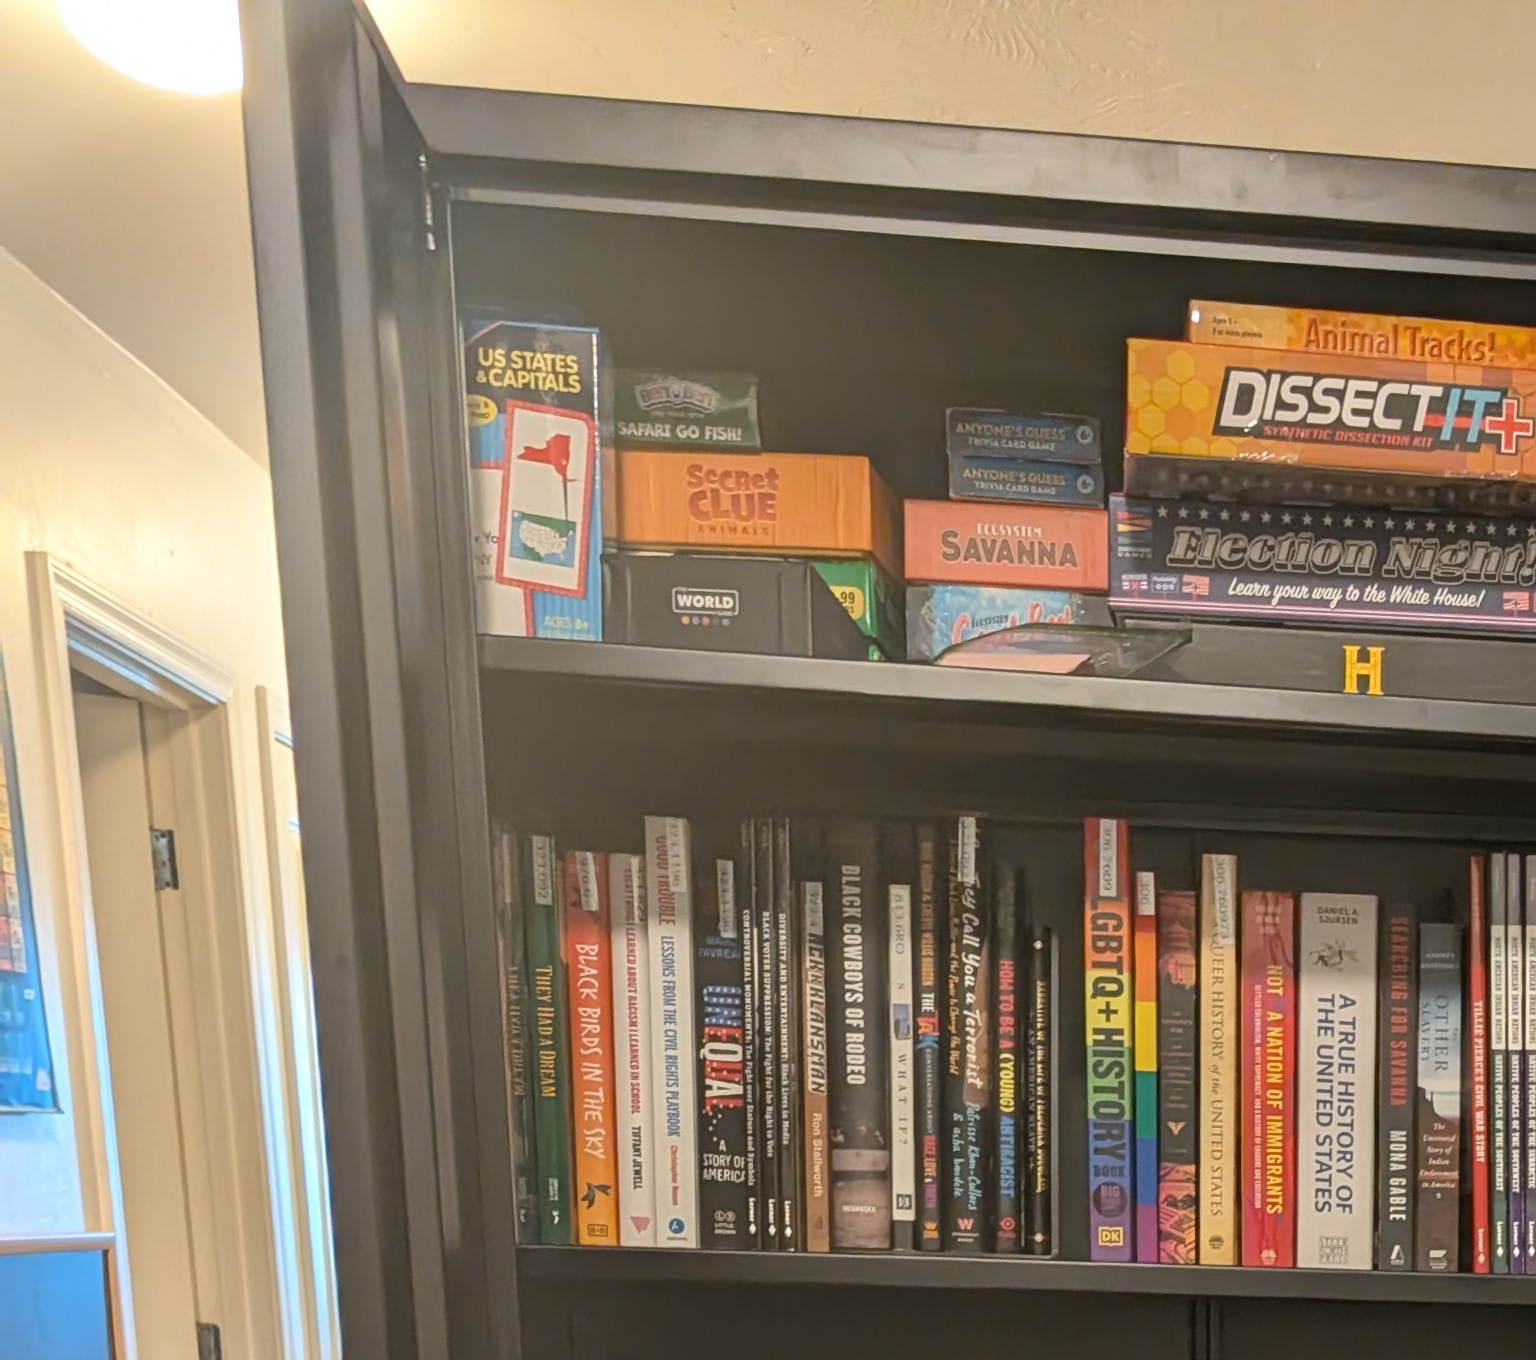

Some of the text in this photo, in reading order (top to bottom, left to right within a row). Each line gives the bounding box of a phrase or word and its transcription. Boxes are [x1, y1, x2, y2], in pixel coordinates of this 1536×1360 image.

[1303, 318, 1496, 362] Animal Tracks!
[477, 348, 578, 373] US STATES
[618, 422, 742, 441] SAFARI GO FISH!
[956, 423, 1065, 441] ANYONE'S GUESS
[689, 488, 776, 522] CLUE
[976, 523, 1042, 539] ECOSYSTEM
[941, 530, 1079, 569] SAVANNA
[1166, 526, 1374, 575] Election
[677, 593, 734, 611] WORLD
[1228, 577, 1486, 609] Learn your way to the White House!
[1343, 645, 1385, 696] H
[842, 865, 866, 1086] BLACK COWBOYS OF RODEO
[575, 944, 606, 1160] BLACK BIRDS IN THE SKY
[1315, 994, 1335, 1213] THE UNITED STATES
[1336, 994, 1357, 1215] A TRUE HISTORY OF
[1101, 1230, 1120, 1244] DK
